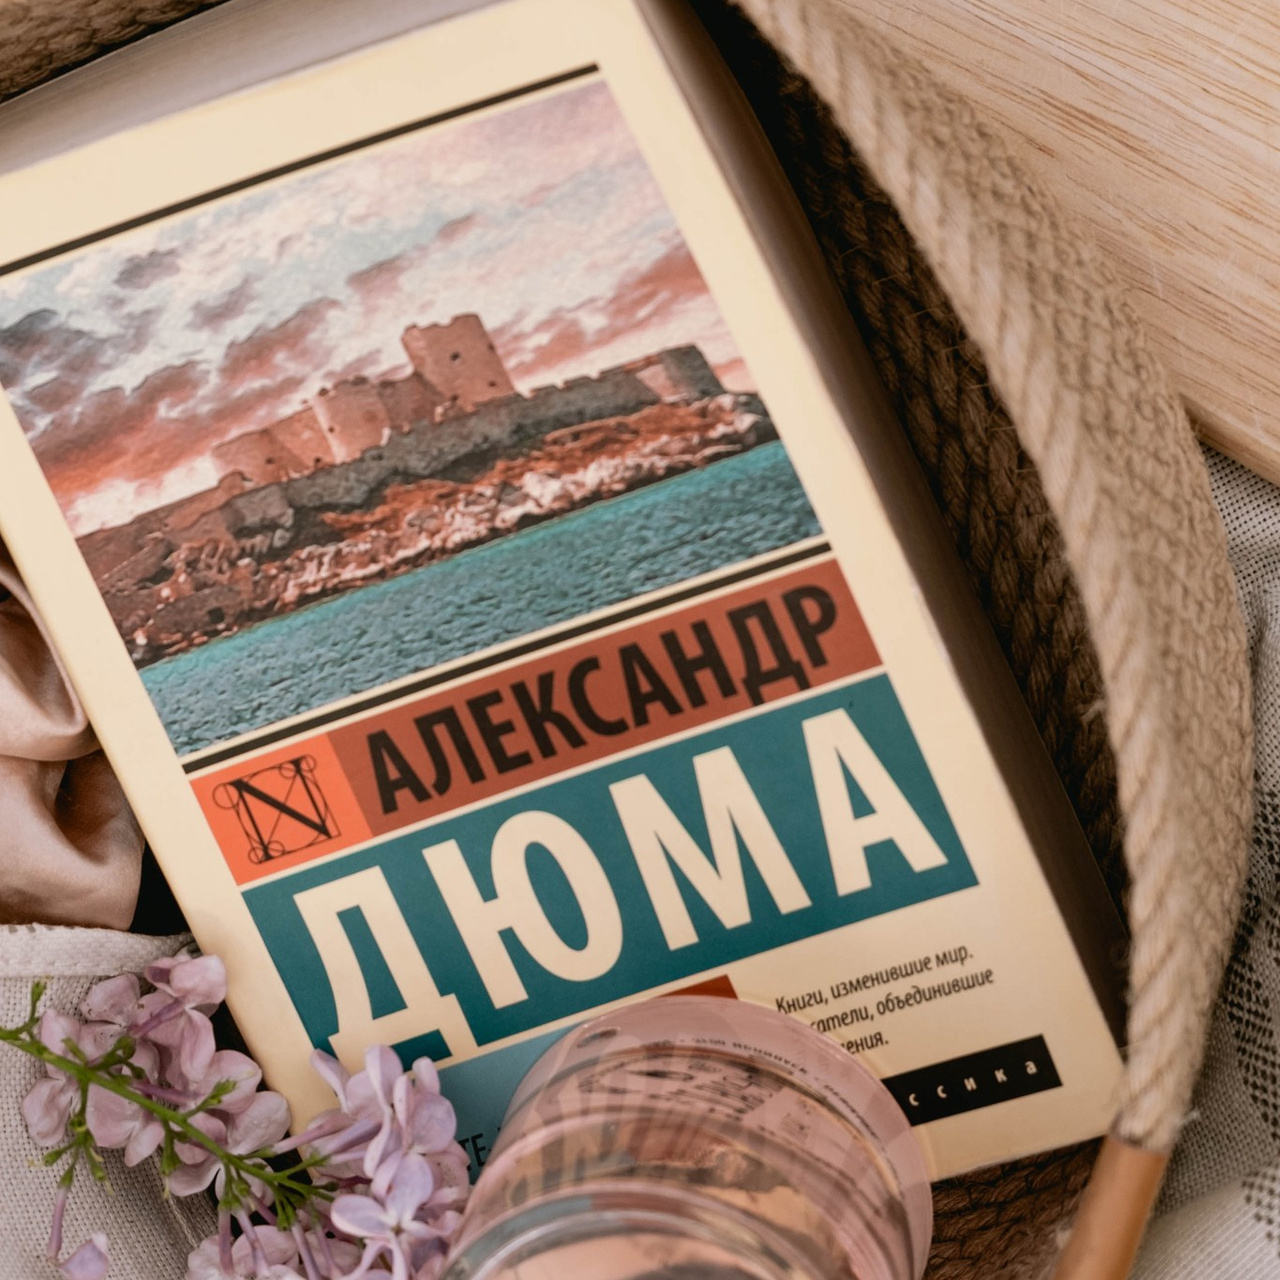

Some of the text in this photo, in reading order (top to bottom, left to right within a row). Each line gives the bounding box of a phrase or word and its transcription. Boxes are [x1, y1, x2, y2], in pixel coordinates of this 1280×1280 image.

[366, 585, 837, 814] АЛЕКСАНДР
[294, 707, 947, 1070] ДЮМА
[775, 943, 974, 1015] Книги, изменившие мир.
[810, 968, 994, 1034] атели, объединившие
[841, 1031, 889, 1055] ения.
[908, 1060, 1038, 1107] ссика
